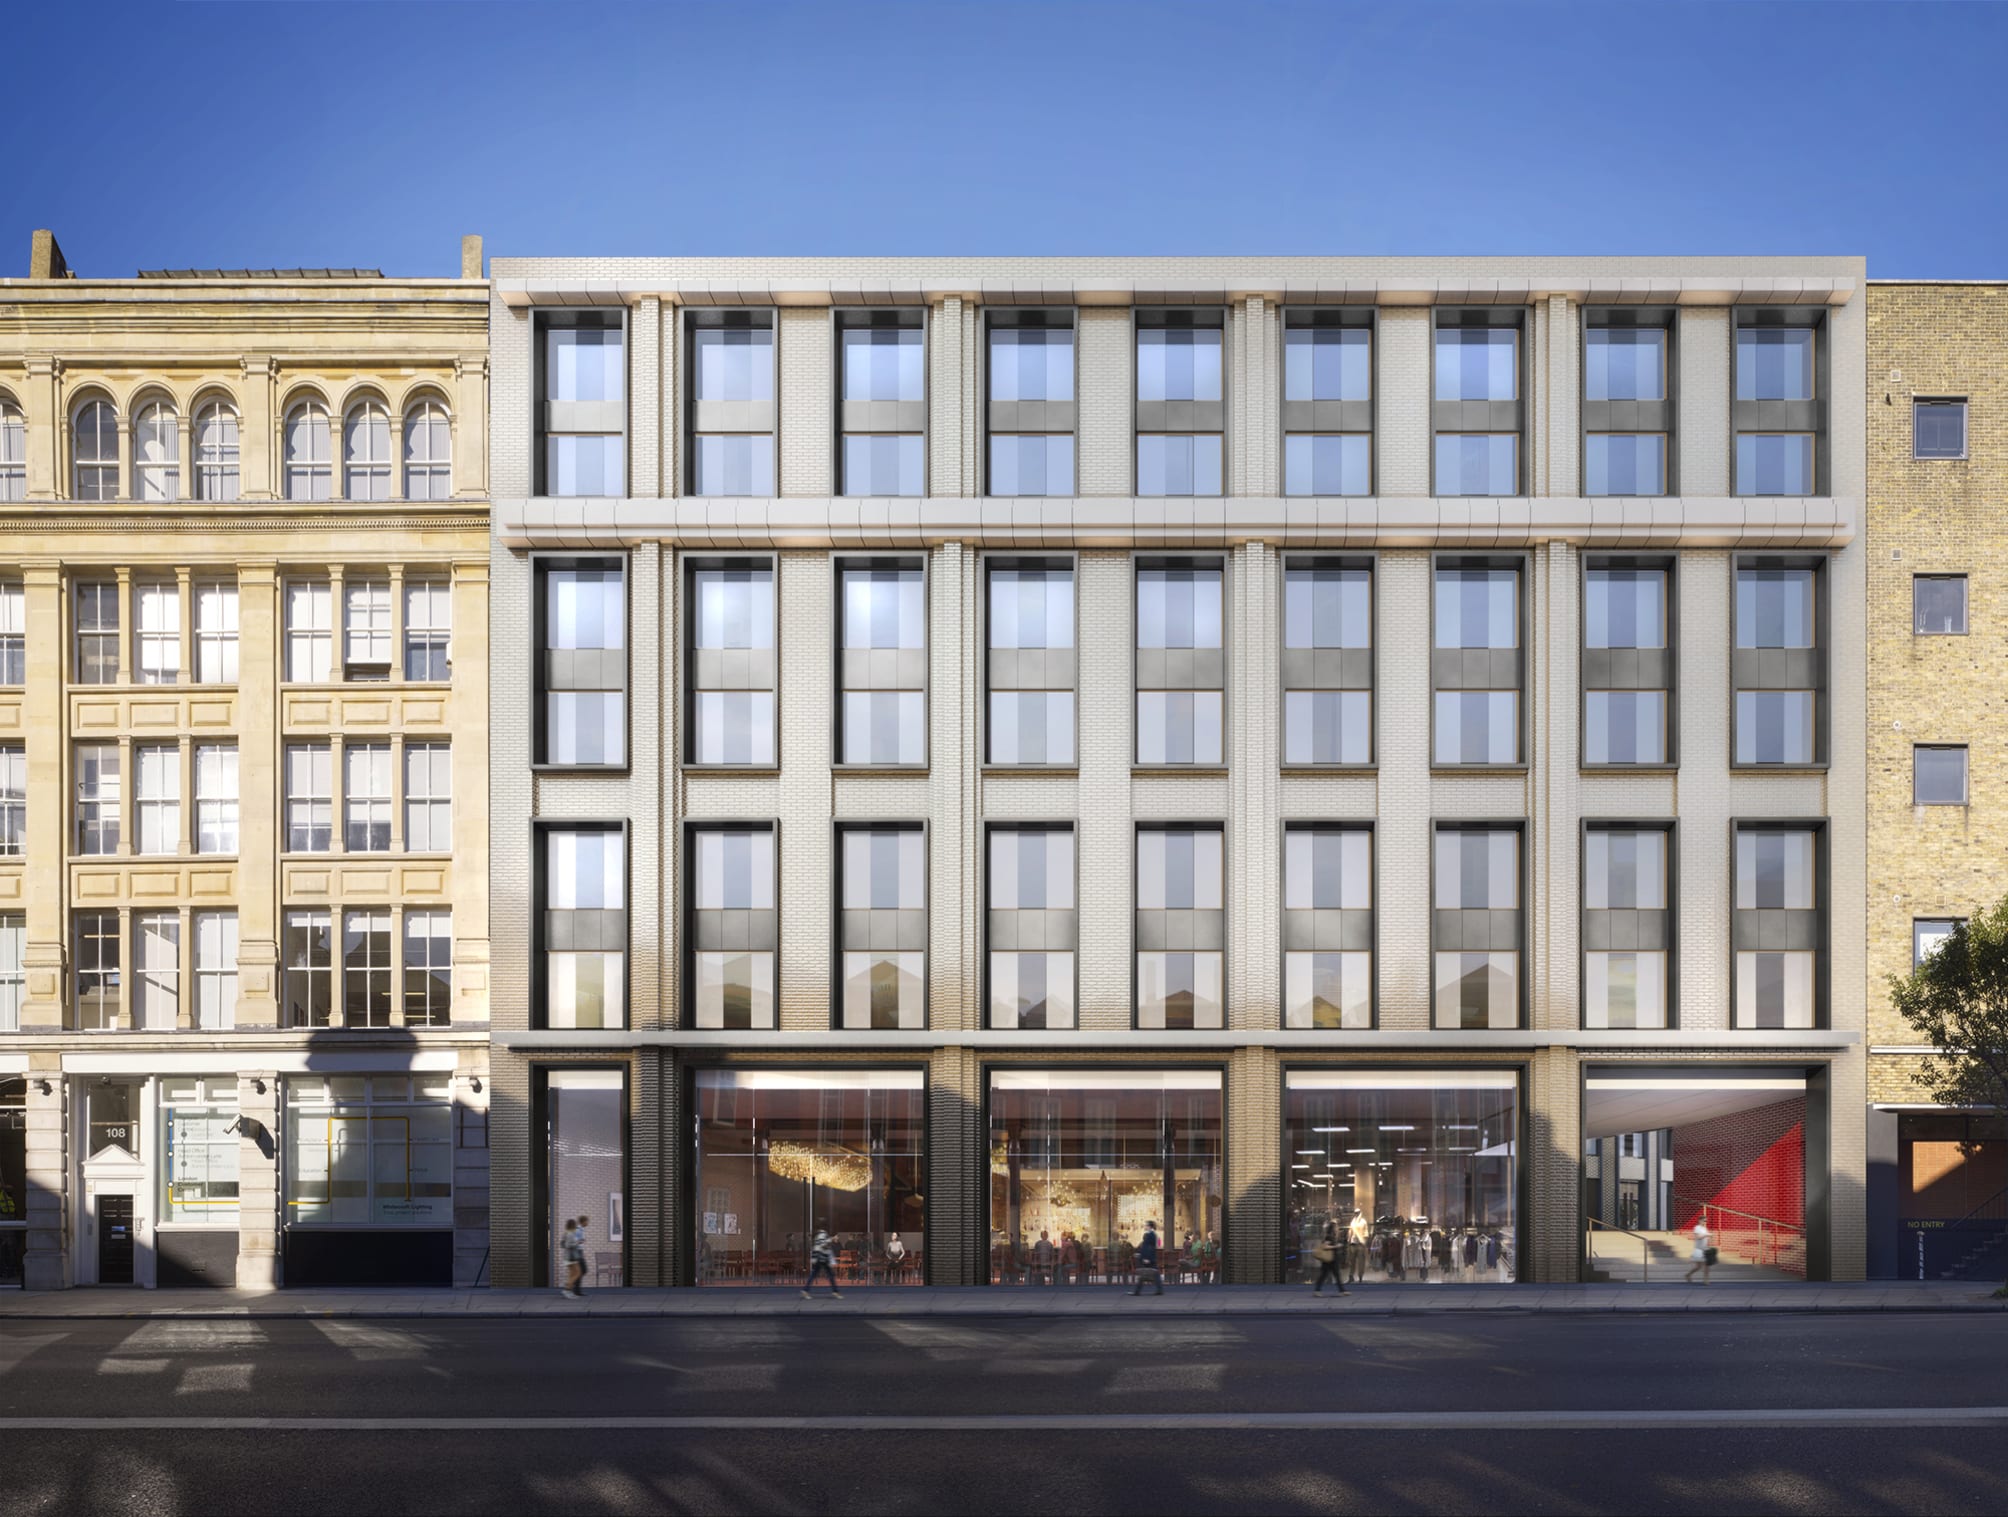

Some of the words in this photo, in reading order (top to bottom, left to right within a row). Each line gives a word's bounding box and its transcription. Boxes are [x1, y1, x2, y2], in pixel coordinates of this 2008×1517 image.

[105, 1127, 126, 1138] 108
[1907, 1220, 1920, 1228] NO
[1921, 1220, 1945, 1228] ENTRY
